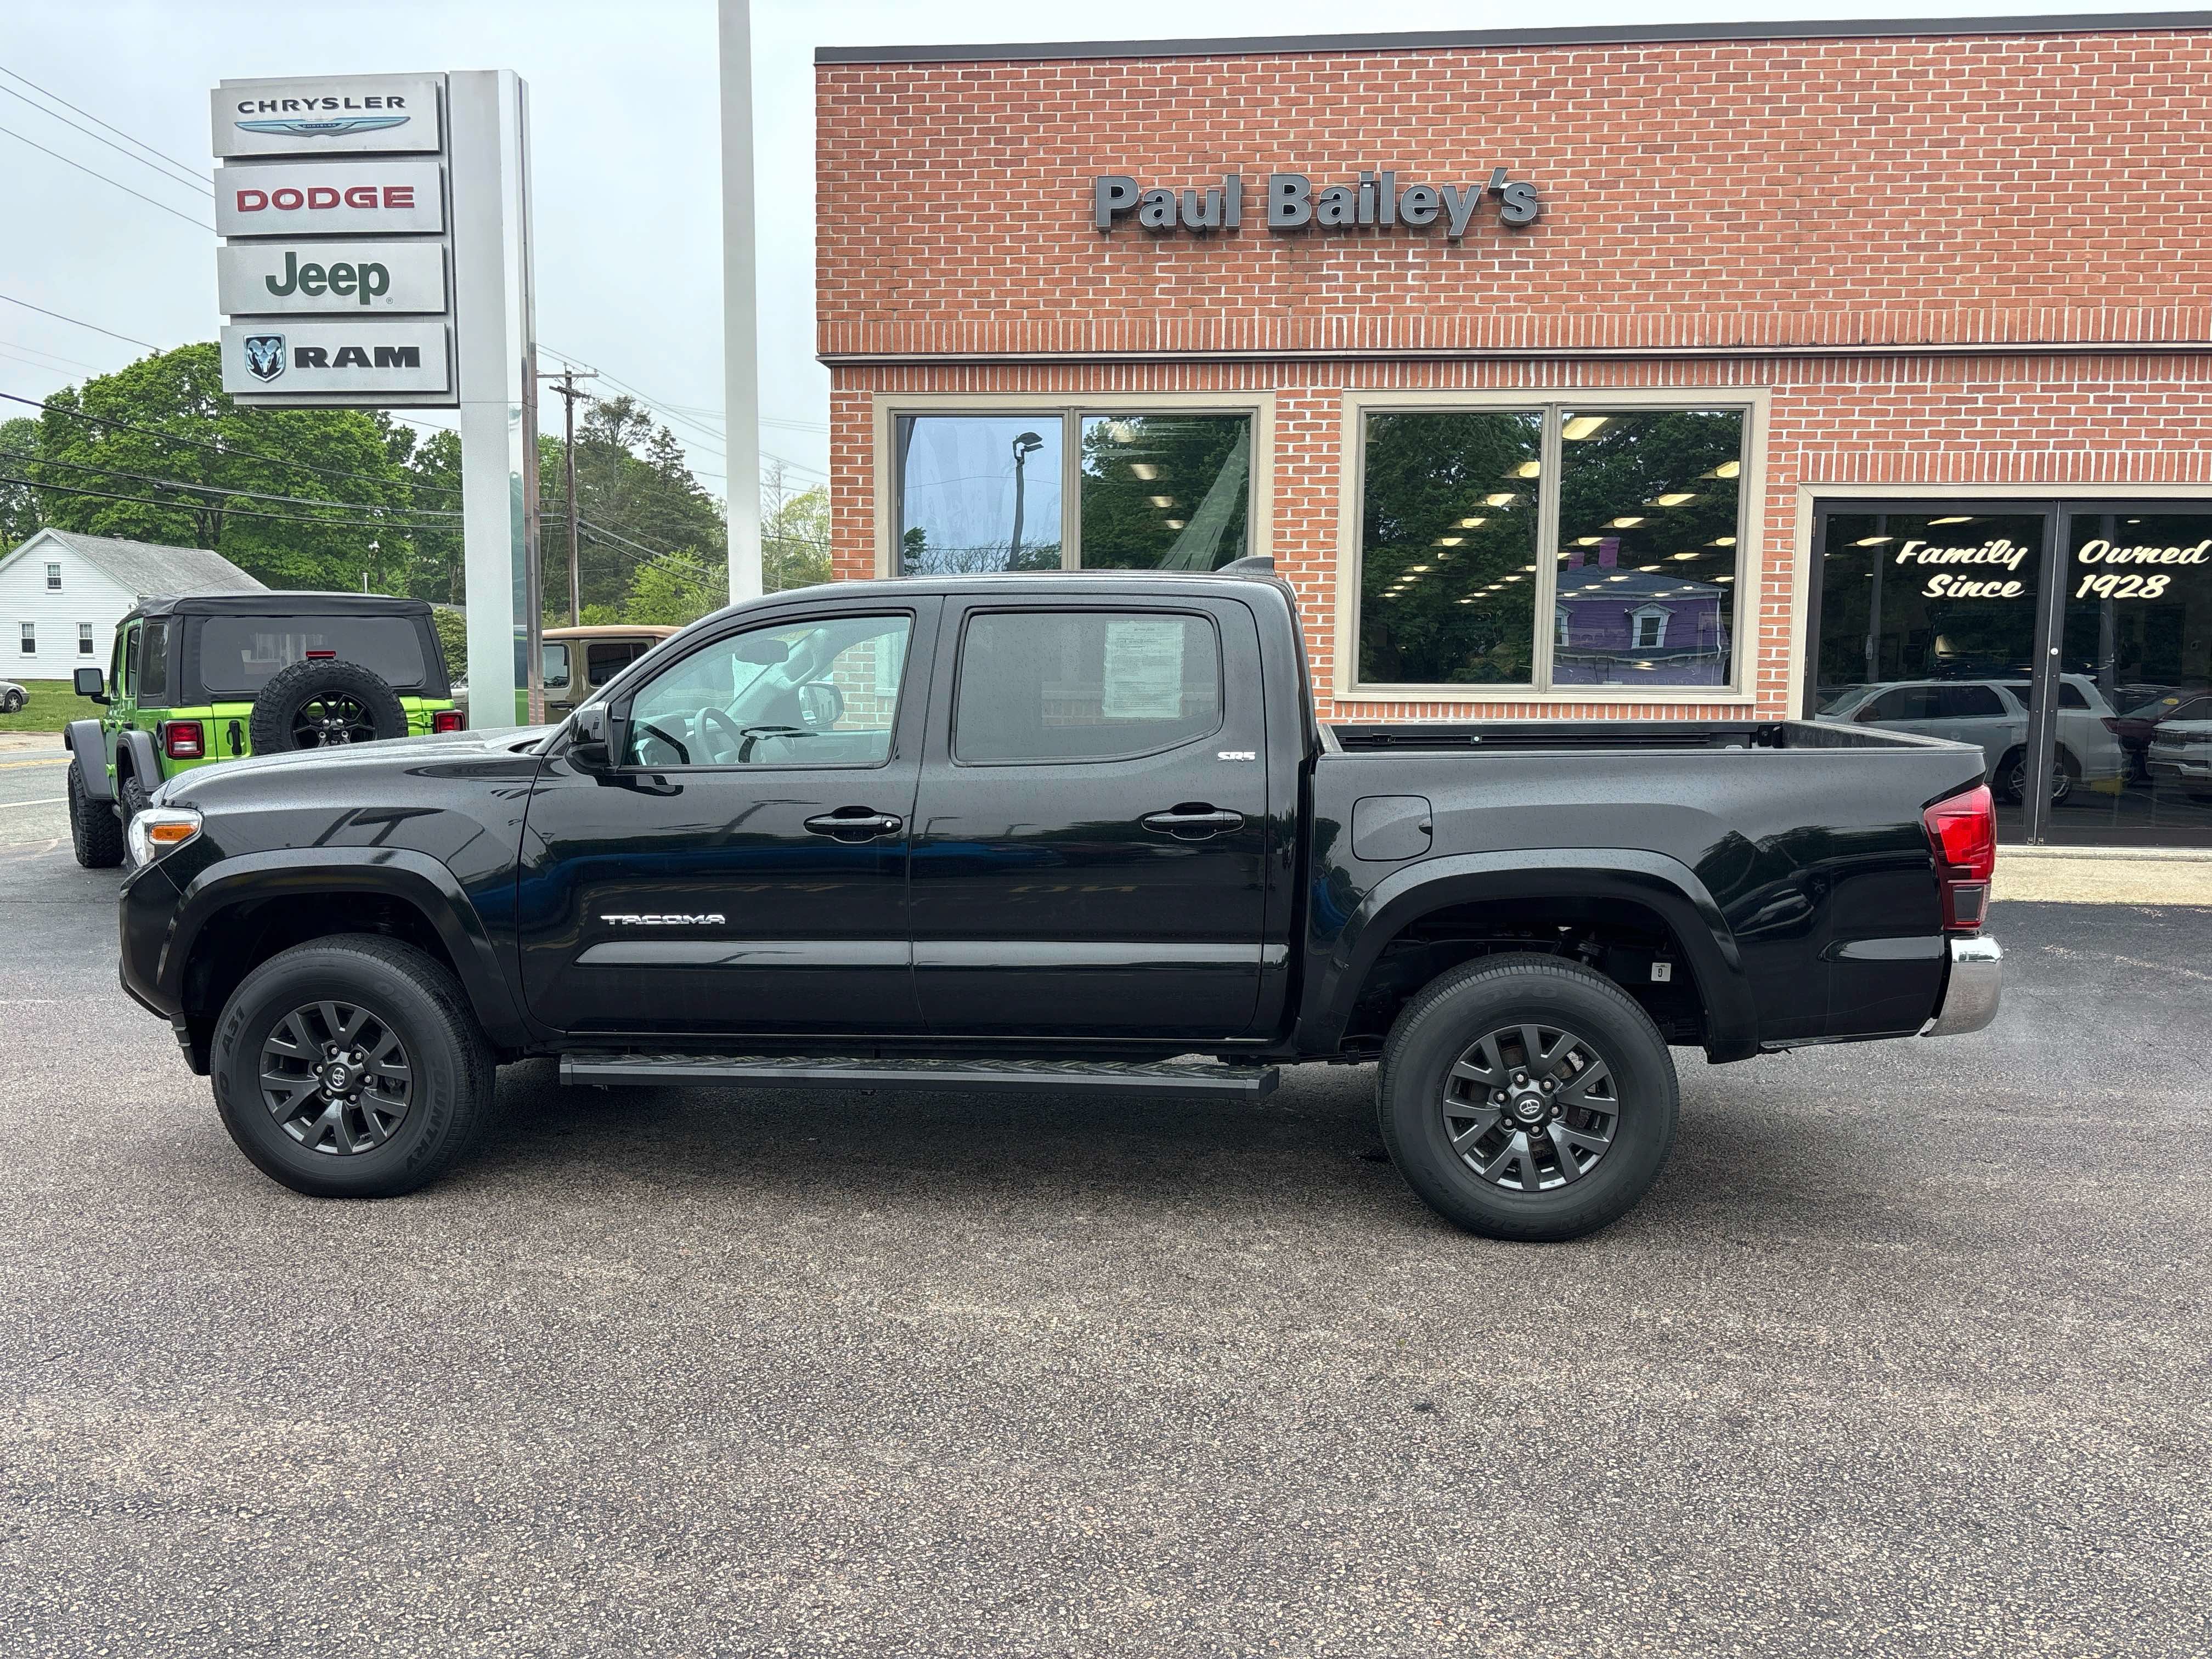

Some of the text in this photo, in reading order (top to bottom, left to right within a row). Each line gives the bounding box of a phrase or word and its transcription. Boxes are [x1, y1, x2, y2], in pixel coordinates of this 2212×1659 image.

[238, 96, 406, 114] CHRYSLER
[236, 186, 415, 212] DODGE
[1096, 167, 1538, 240] Paul Bailey's
[265, 251, 390, 305] Jeep
[294, 346, 421, 368] RAM
[1895, 539, 2212, 571] Family Owned
[1921, 574, 2171, 599] Since 1928
[1217, 752, 1256, 761] SR5
[600, 915, 725, 925] TACOMA
